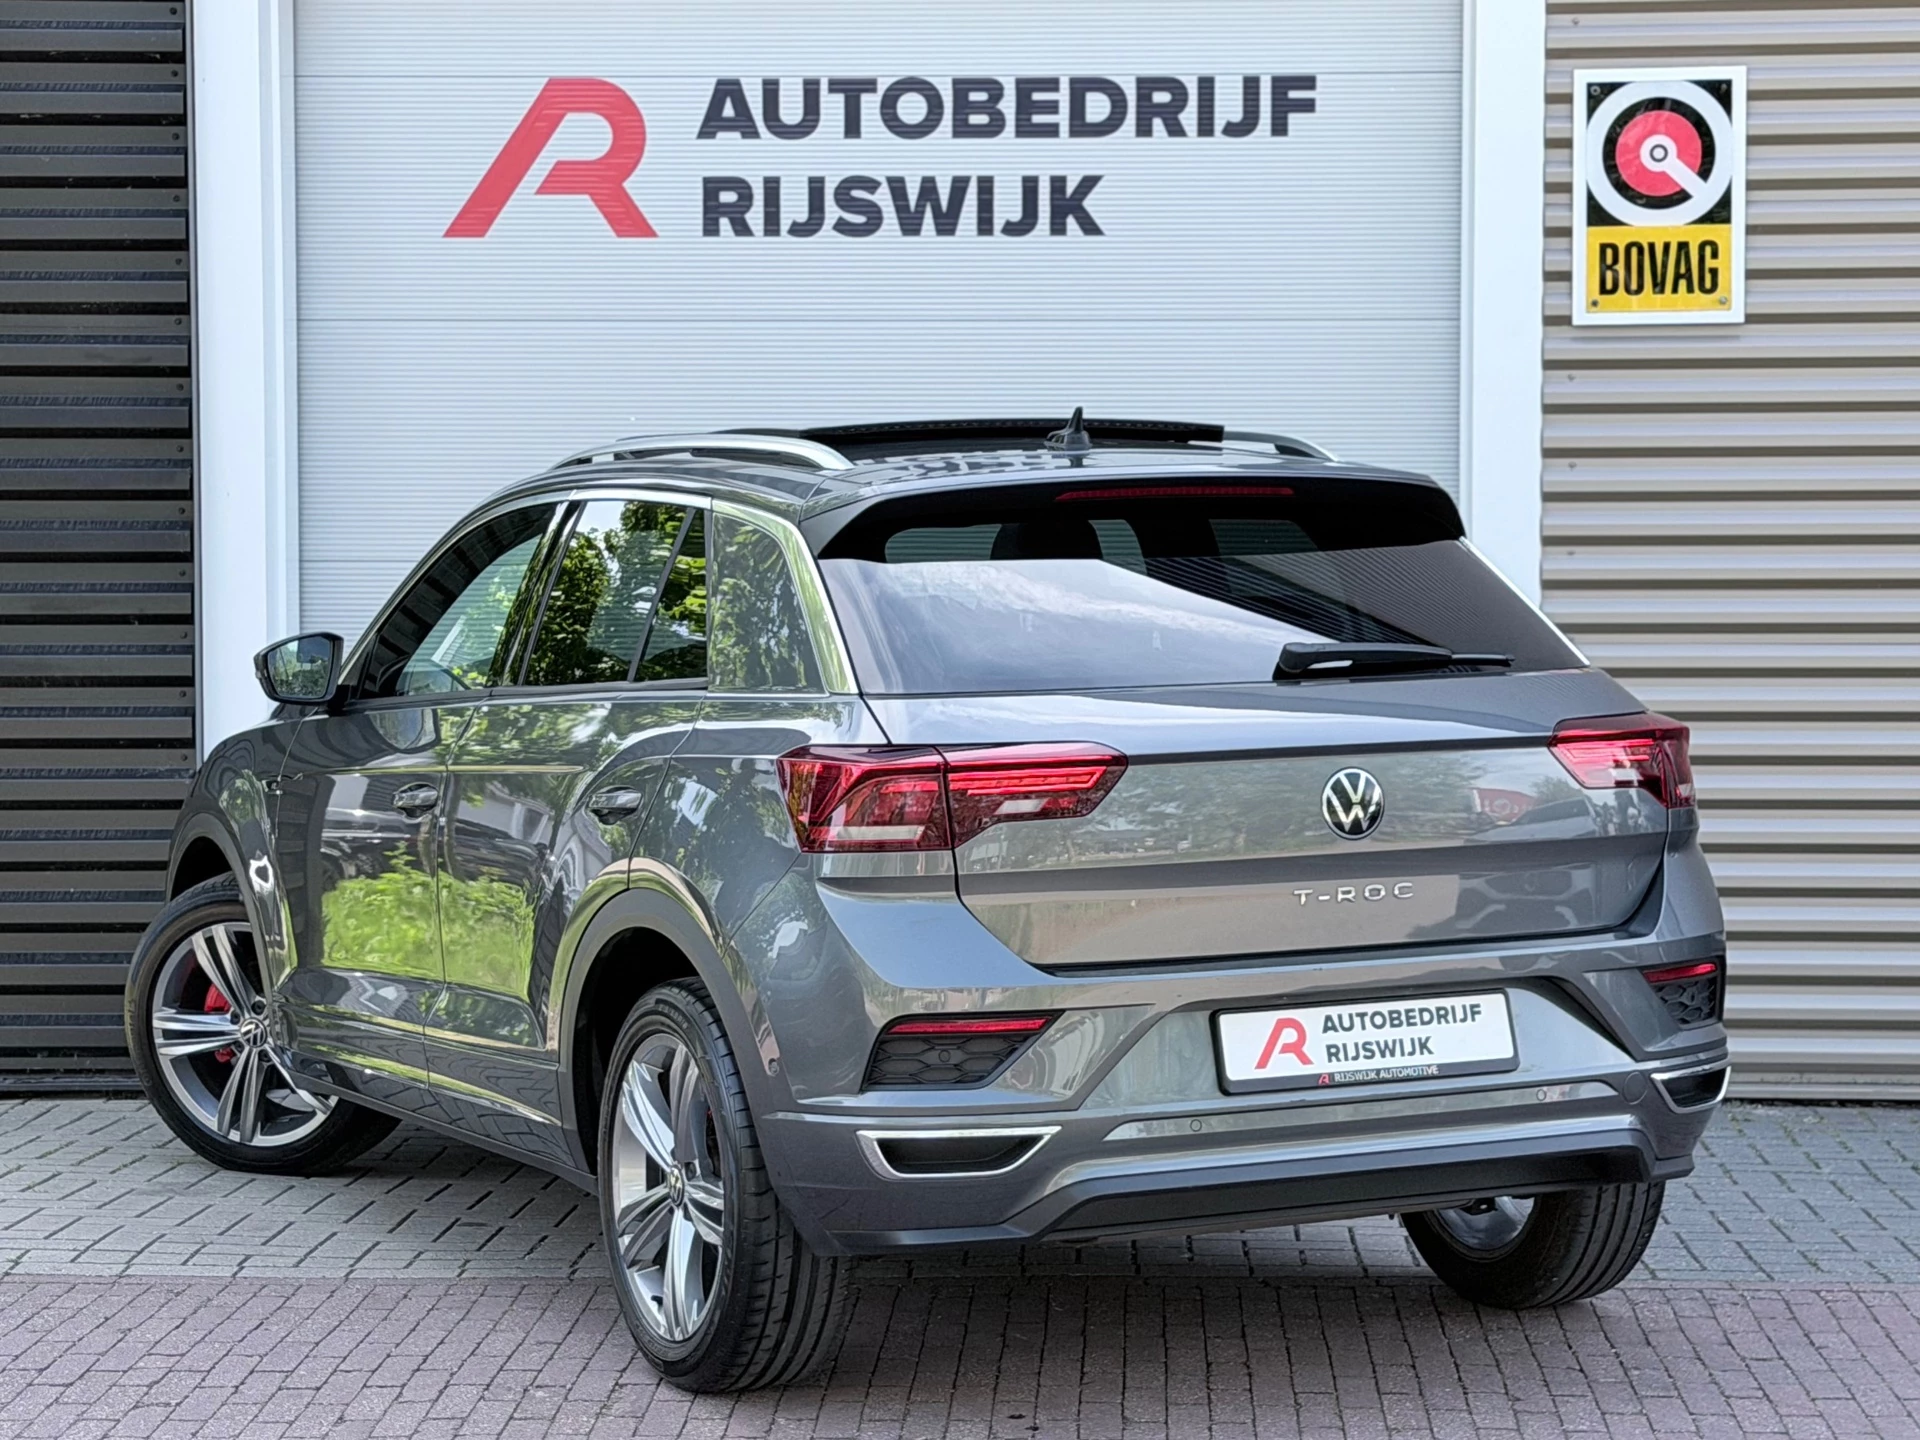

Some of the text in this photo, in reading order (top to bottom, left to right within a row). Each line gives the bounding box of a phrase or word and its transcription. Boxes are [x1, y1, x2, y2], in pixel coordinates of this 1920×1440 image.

[697, 75, 1317, 140] AUTOBEDRIJF
[702, 175, 1105, 238] RIJSWIJK
[1599, 240, 1719, 296] BOVAG
[1294, 882, 1413, 905] T-ROC
[1322, 1004, 1482, 1034] AUTOBEDRIJF
[1325, 1036, 1434, 1063] RIJSWIJK
[1333, 1070, 1377, 1083] RIJSWIJK
[1379, 1065, 1439, 1080] AUTOMOTIVE
